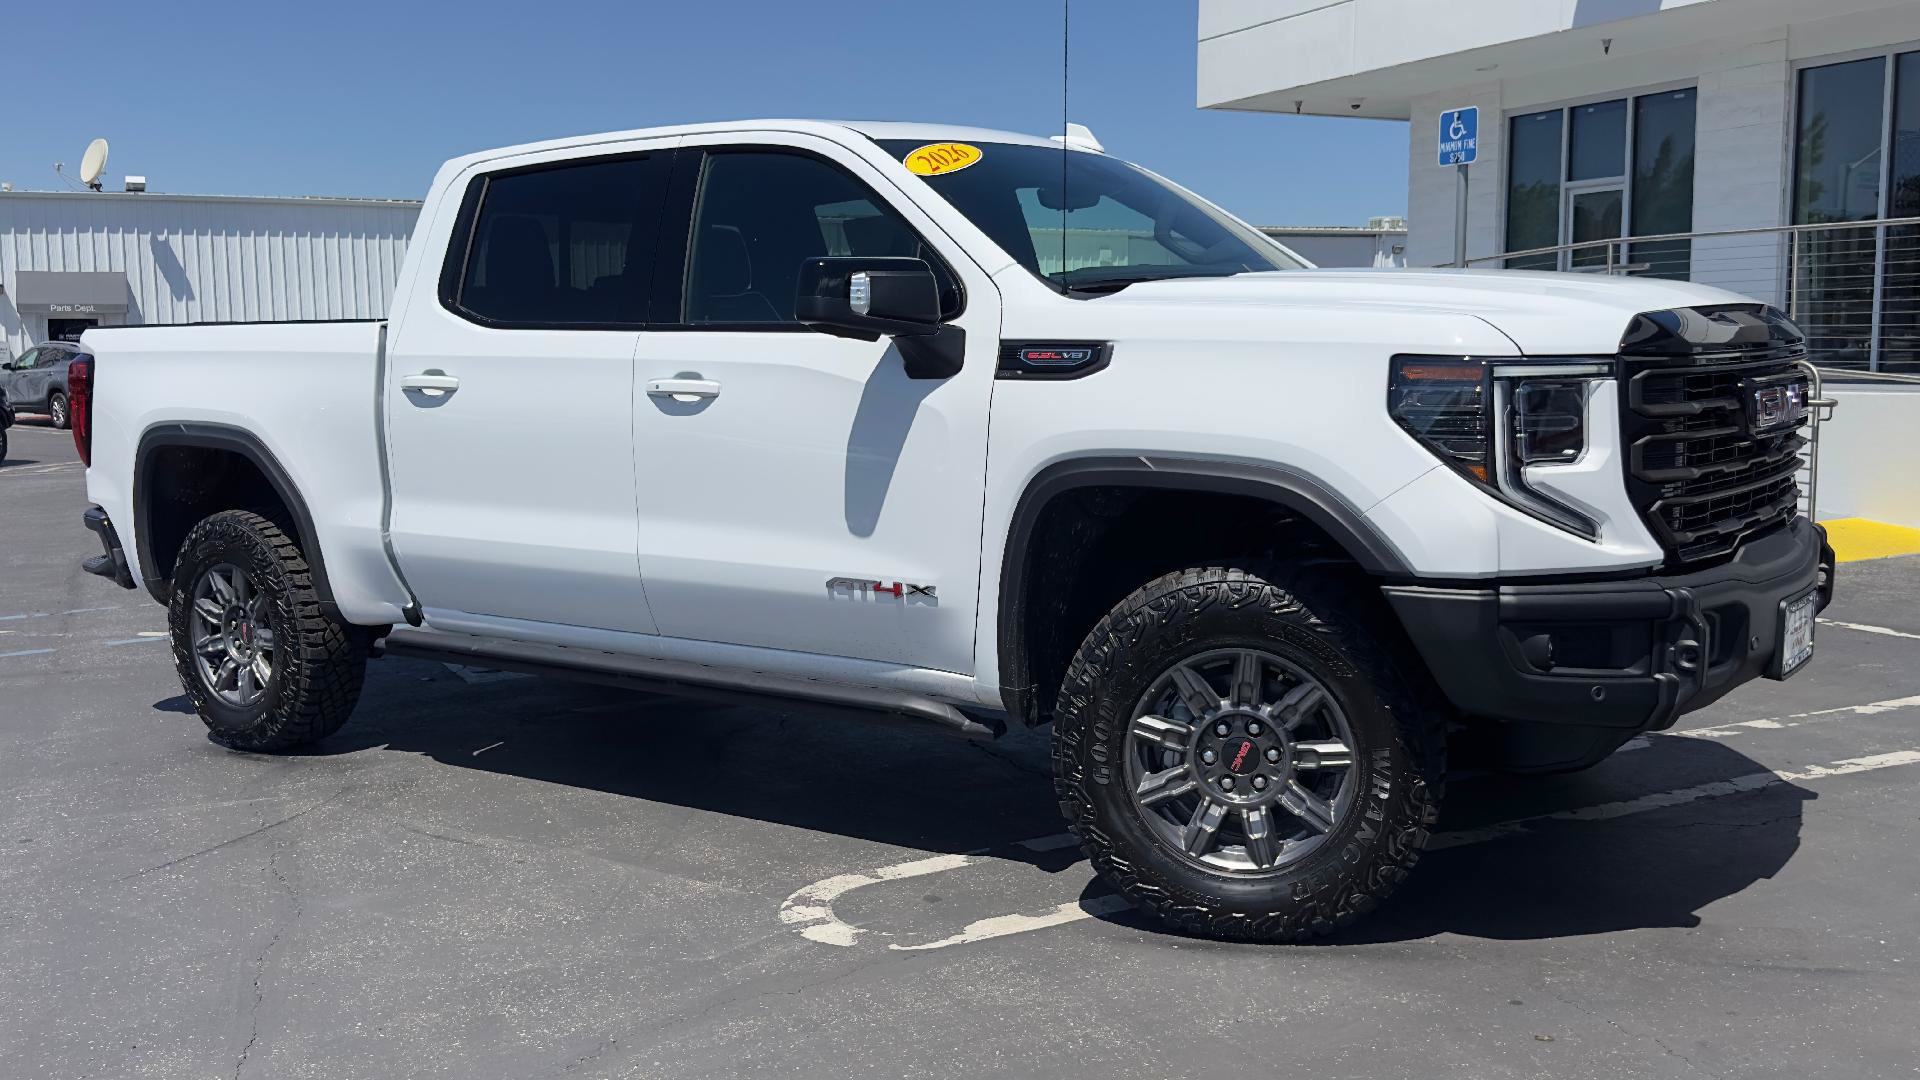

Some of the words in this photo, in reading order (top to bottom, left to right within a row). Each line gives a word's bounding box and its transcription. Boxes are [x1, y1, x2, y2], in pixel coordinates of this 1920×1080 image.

[1463, 138, 1476, 150] FINE
[917, 145, 970, 172] 2026
[1449, 151, 1465, 163] $250
[50, 304, 72, 312] Parts
[74, 304, 96, 313] Dept.
[1062, 351, 1084, 360] V8
[825, 576, 938, 607] AT4X
[1231, 741, 1251, 771] GMC
